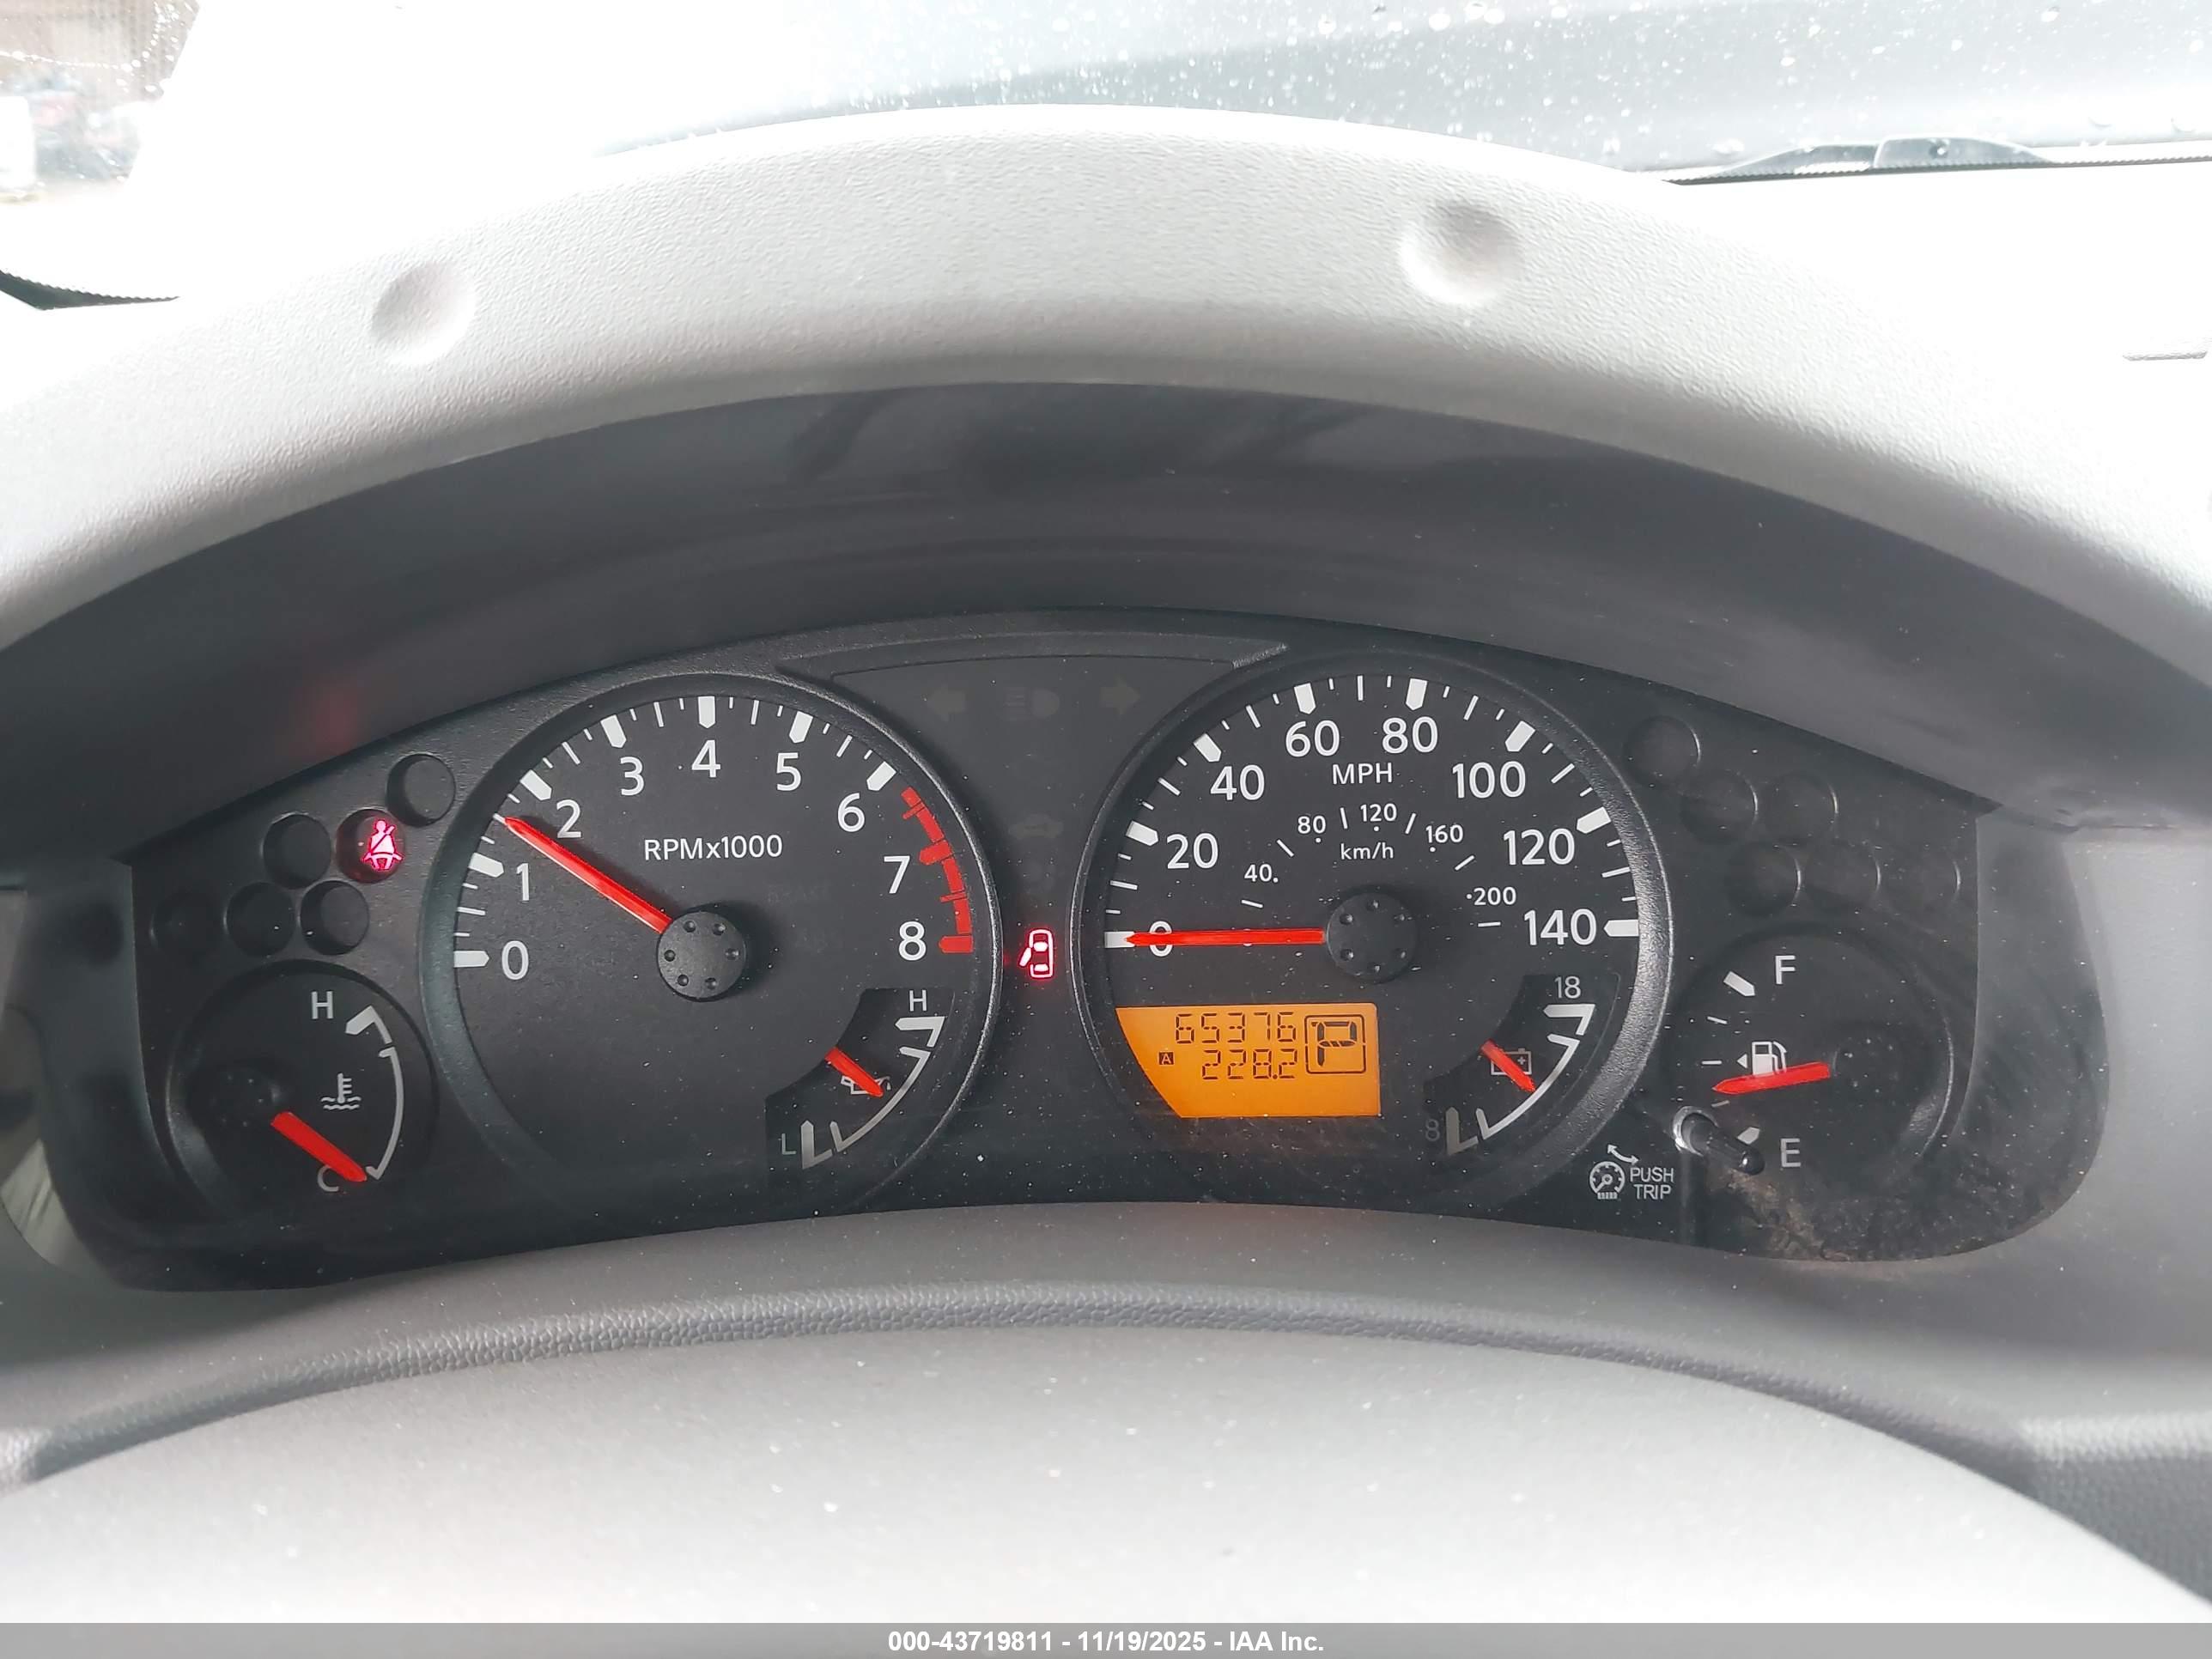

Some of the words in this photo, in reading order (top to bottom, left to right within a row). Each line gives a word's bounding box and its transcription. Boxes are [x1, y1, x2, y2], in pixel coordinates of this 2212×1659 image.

[1285, 720, 1340, 757] 60
[1382, 716, 1438, 754] 80
[691, 739, 721, 778] 4
[776, 752, 801, 791] 5
[1333, 762, 1393, 785] MPH
[620, 756, 644, 796] 3
[1210, 764, 1265, 800] 40
[1452, 761, 1526, 799] 100
[556, 799, 582, 839] 2
[837, 793, 866, 832] 6
[1297, 814, 1327, 835] 80
[1360, 803, 1398, 823] 120
[644, 834, 783, 860] RPMx1000
[1425, 823, 1464, 844] 160
[1504, 828, 1575, 866] 120
[1166, 832, 1218, 869] 20
[1340, 842, 1395, 860] km/h
[516, 862, 530, 902] 1
[884, 855, 911, 894] 7
[1243, 863, 1273, 883] 40
[1473, 886, 1517, 906] 200
[898, 921, 927, 961] 8
[1149, 921, 1173, 957] 0
[1524, 909, 1597, 945] 140
[501, 940, 529, 981] 0
[1775, 955, 1796, 985] F
[908, 989, 928, 1012] H
[1555, 975, 1582, 999] 18
[311, 991, 334, 1019] H
[1175, 1012, 1297, 1044] 65376
[1311, 1021, 1358, 1066] P
[1160, 1053, 1172, 1064] A
[1202, 1048, 1298, 1079] 228.2
[781, 1133, 797, 1156] L
[1425, 1118, 1441, 1142] 8
[1780, 1138, 1802, 1168] E
[1630, 1166, 1674, 1183] PUSH
[1633, 1183, 1673, 1200] TRIP
